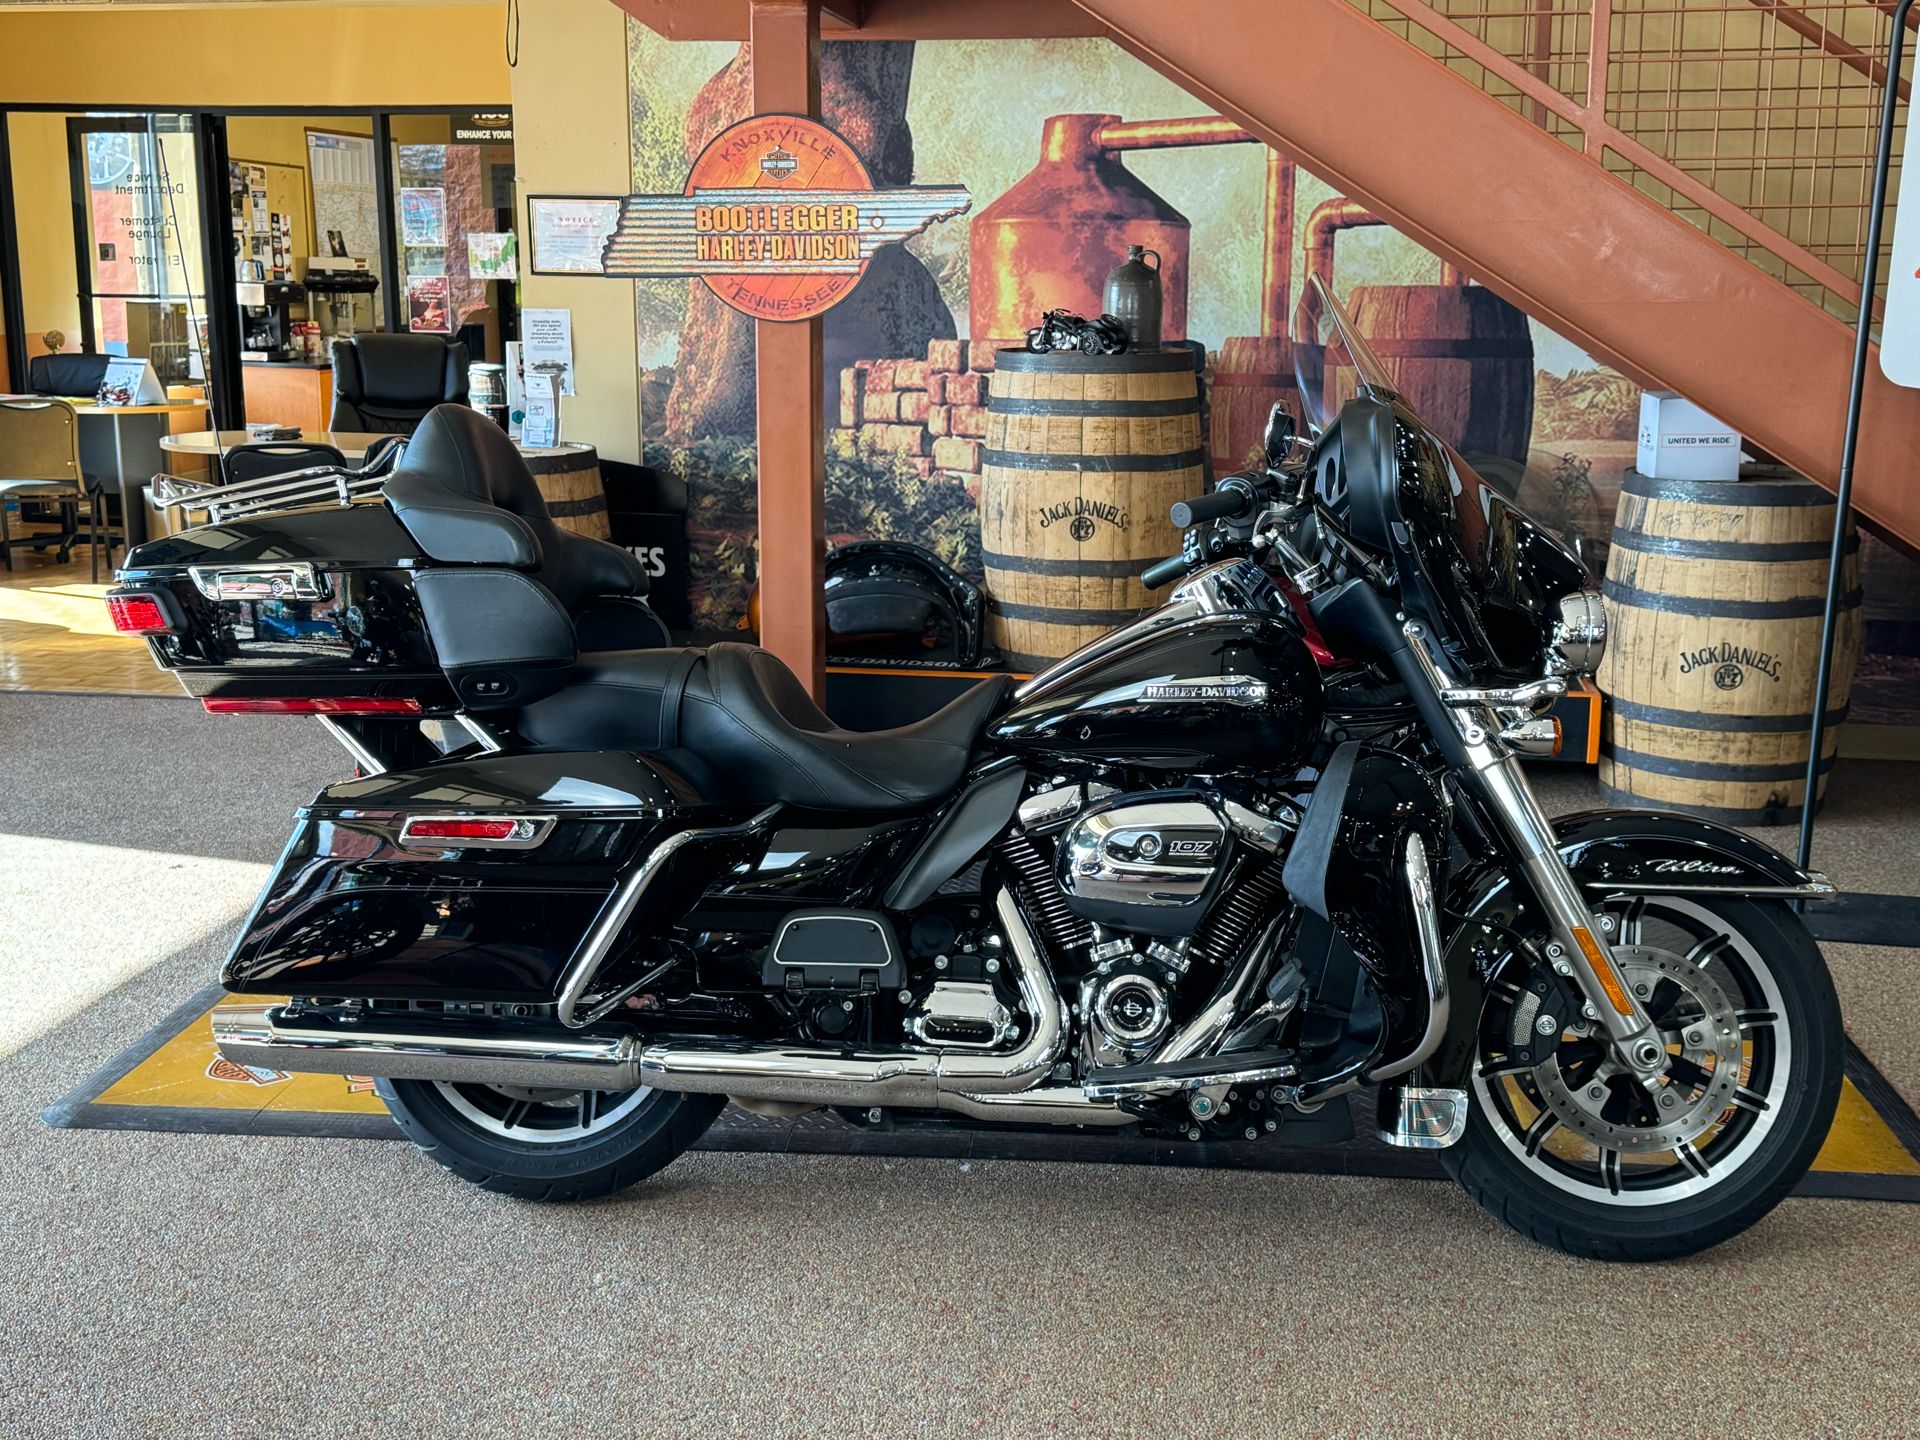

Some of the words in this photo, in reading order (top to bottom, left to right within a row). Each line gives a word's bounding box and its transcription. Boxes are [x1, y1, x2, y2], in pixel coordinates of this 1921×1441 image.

[456, 129, 491, 139] ENHANCE
[491, 129, 512, 139] YOUR
[719, 129, 836, 162] KNOXVILLE
[696, 205, 859, 232] BOOTLEGGER
[696, 235, 860, 260] HARLEY-DAVIDSON
[726, 278, 842, 311] TENNESSEE
[1667, 437, 1697, 445] UNITED
[1039, 500, 1073, 528] JACK
[1074, 496, 1128, 528] DANIEL'S
[826, 655, 961, 668] EY-DAVIDSON
[1679, 646, 1719, 674] JACK
[1720, 642, 1782, 677] DANIEL'S
[1146, 685, 1266, 697] HARLEY-DAVIDSON
[1169, 840, 1213, 852] 107
[1646, 859, 1745, 875] Ultra
